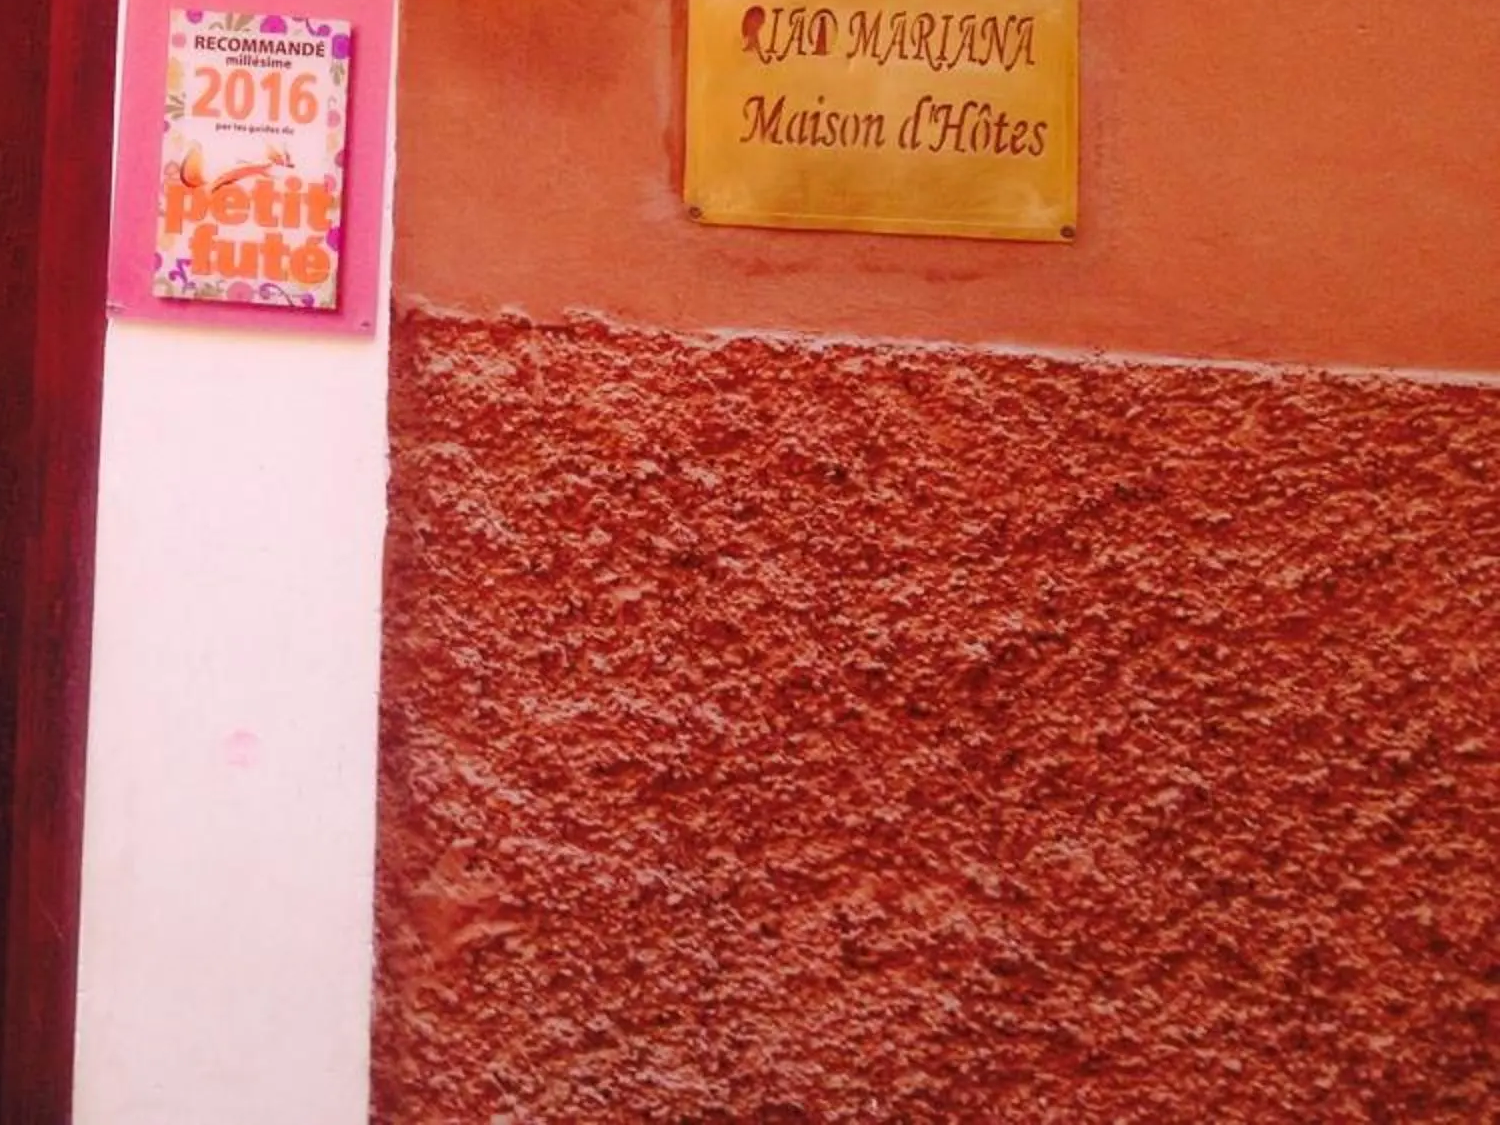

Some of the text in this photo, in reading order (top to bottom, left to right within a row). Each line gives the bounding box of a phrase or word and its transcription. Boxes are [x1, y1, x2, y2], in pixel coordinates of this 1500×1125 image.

[194, 35, 325, 59] RECOMMANDÉ
[225, 54, 291, 70] millésime
[846, 10, 1036, 73] MARIANA
[191, 66, 319, 125] 2016
[739, 94, 1049, 158] Maison d'Hôtes
[163, 175, 334, 234] petit
[189, 222, 332, 285] futé
